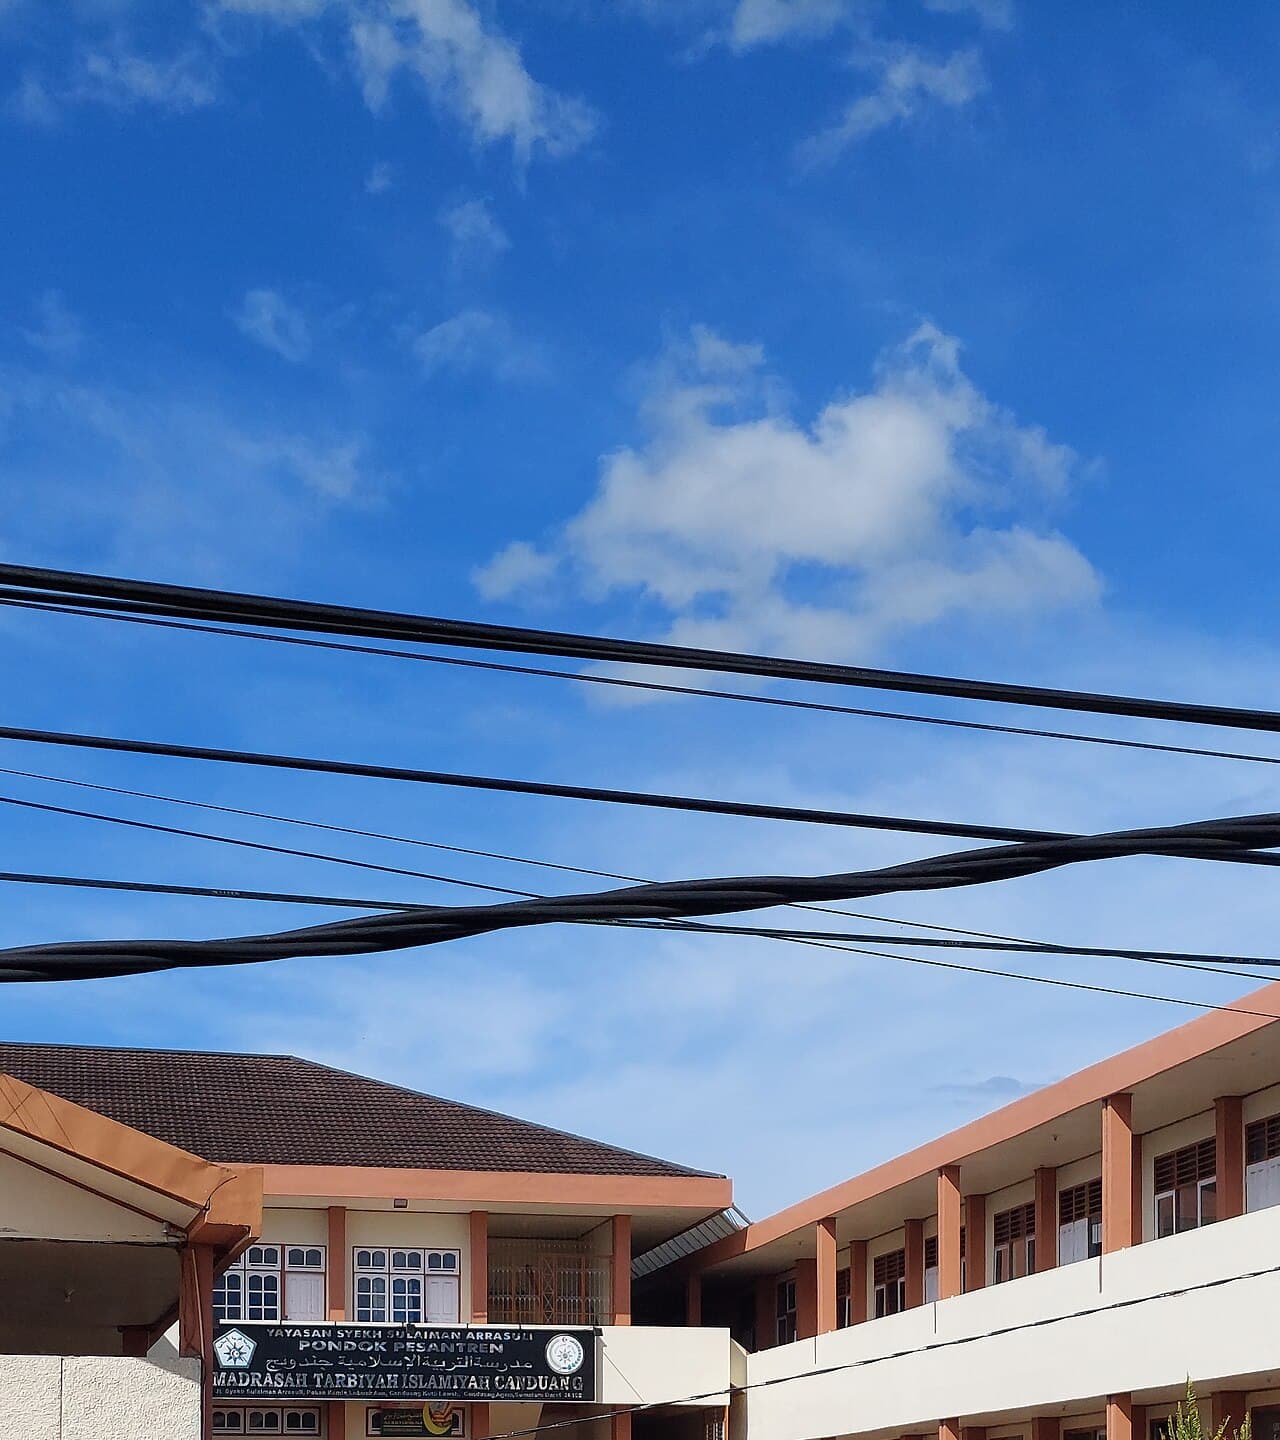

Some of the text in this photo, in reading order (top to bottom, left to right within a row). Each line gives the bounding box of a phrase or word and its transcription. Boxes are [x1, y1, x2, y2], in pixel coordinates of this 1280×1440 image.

[267, 1328, 533, 1341] YAYASAN SYEKH SULAIMAN ARRASULI
[299, 1340, 504, 1354] PONDOK PESANTREN
[213, 1372, 583, 1391] MADRASAH TARBIYAH ISLAMIYAH CANDUANG
